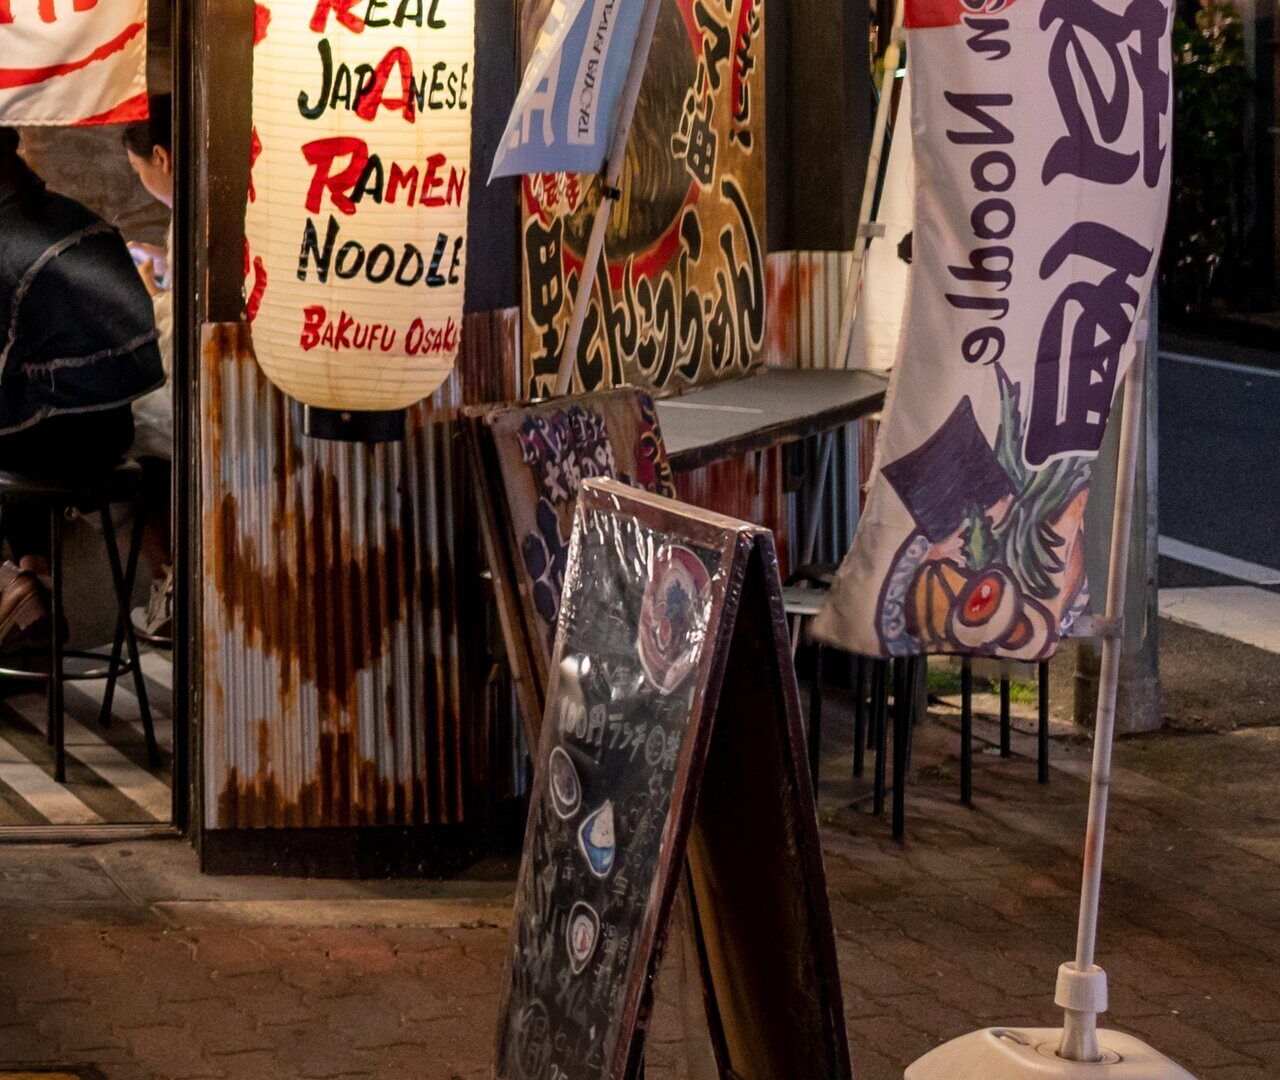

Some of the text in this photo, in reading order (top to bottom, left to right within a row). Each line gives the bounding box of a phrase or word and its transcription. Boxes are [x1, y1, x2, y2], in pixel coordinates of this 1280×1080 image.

[298, 37, 469, 122] JAPANESE
[301, 136, 467, 216] RAMEN
[296, 213, 464, 288] NOODLE
[298, 304, 396, 353] BAKUFU
